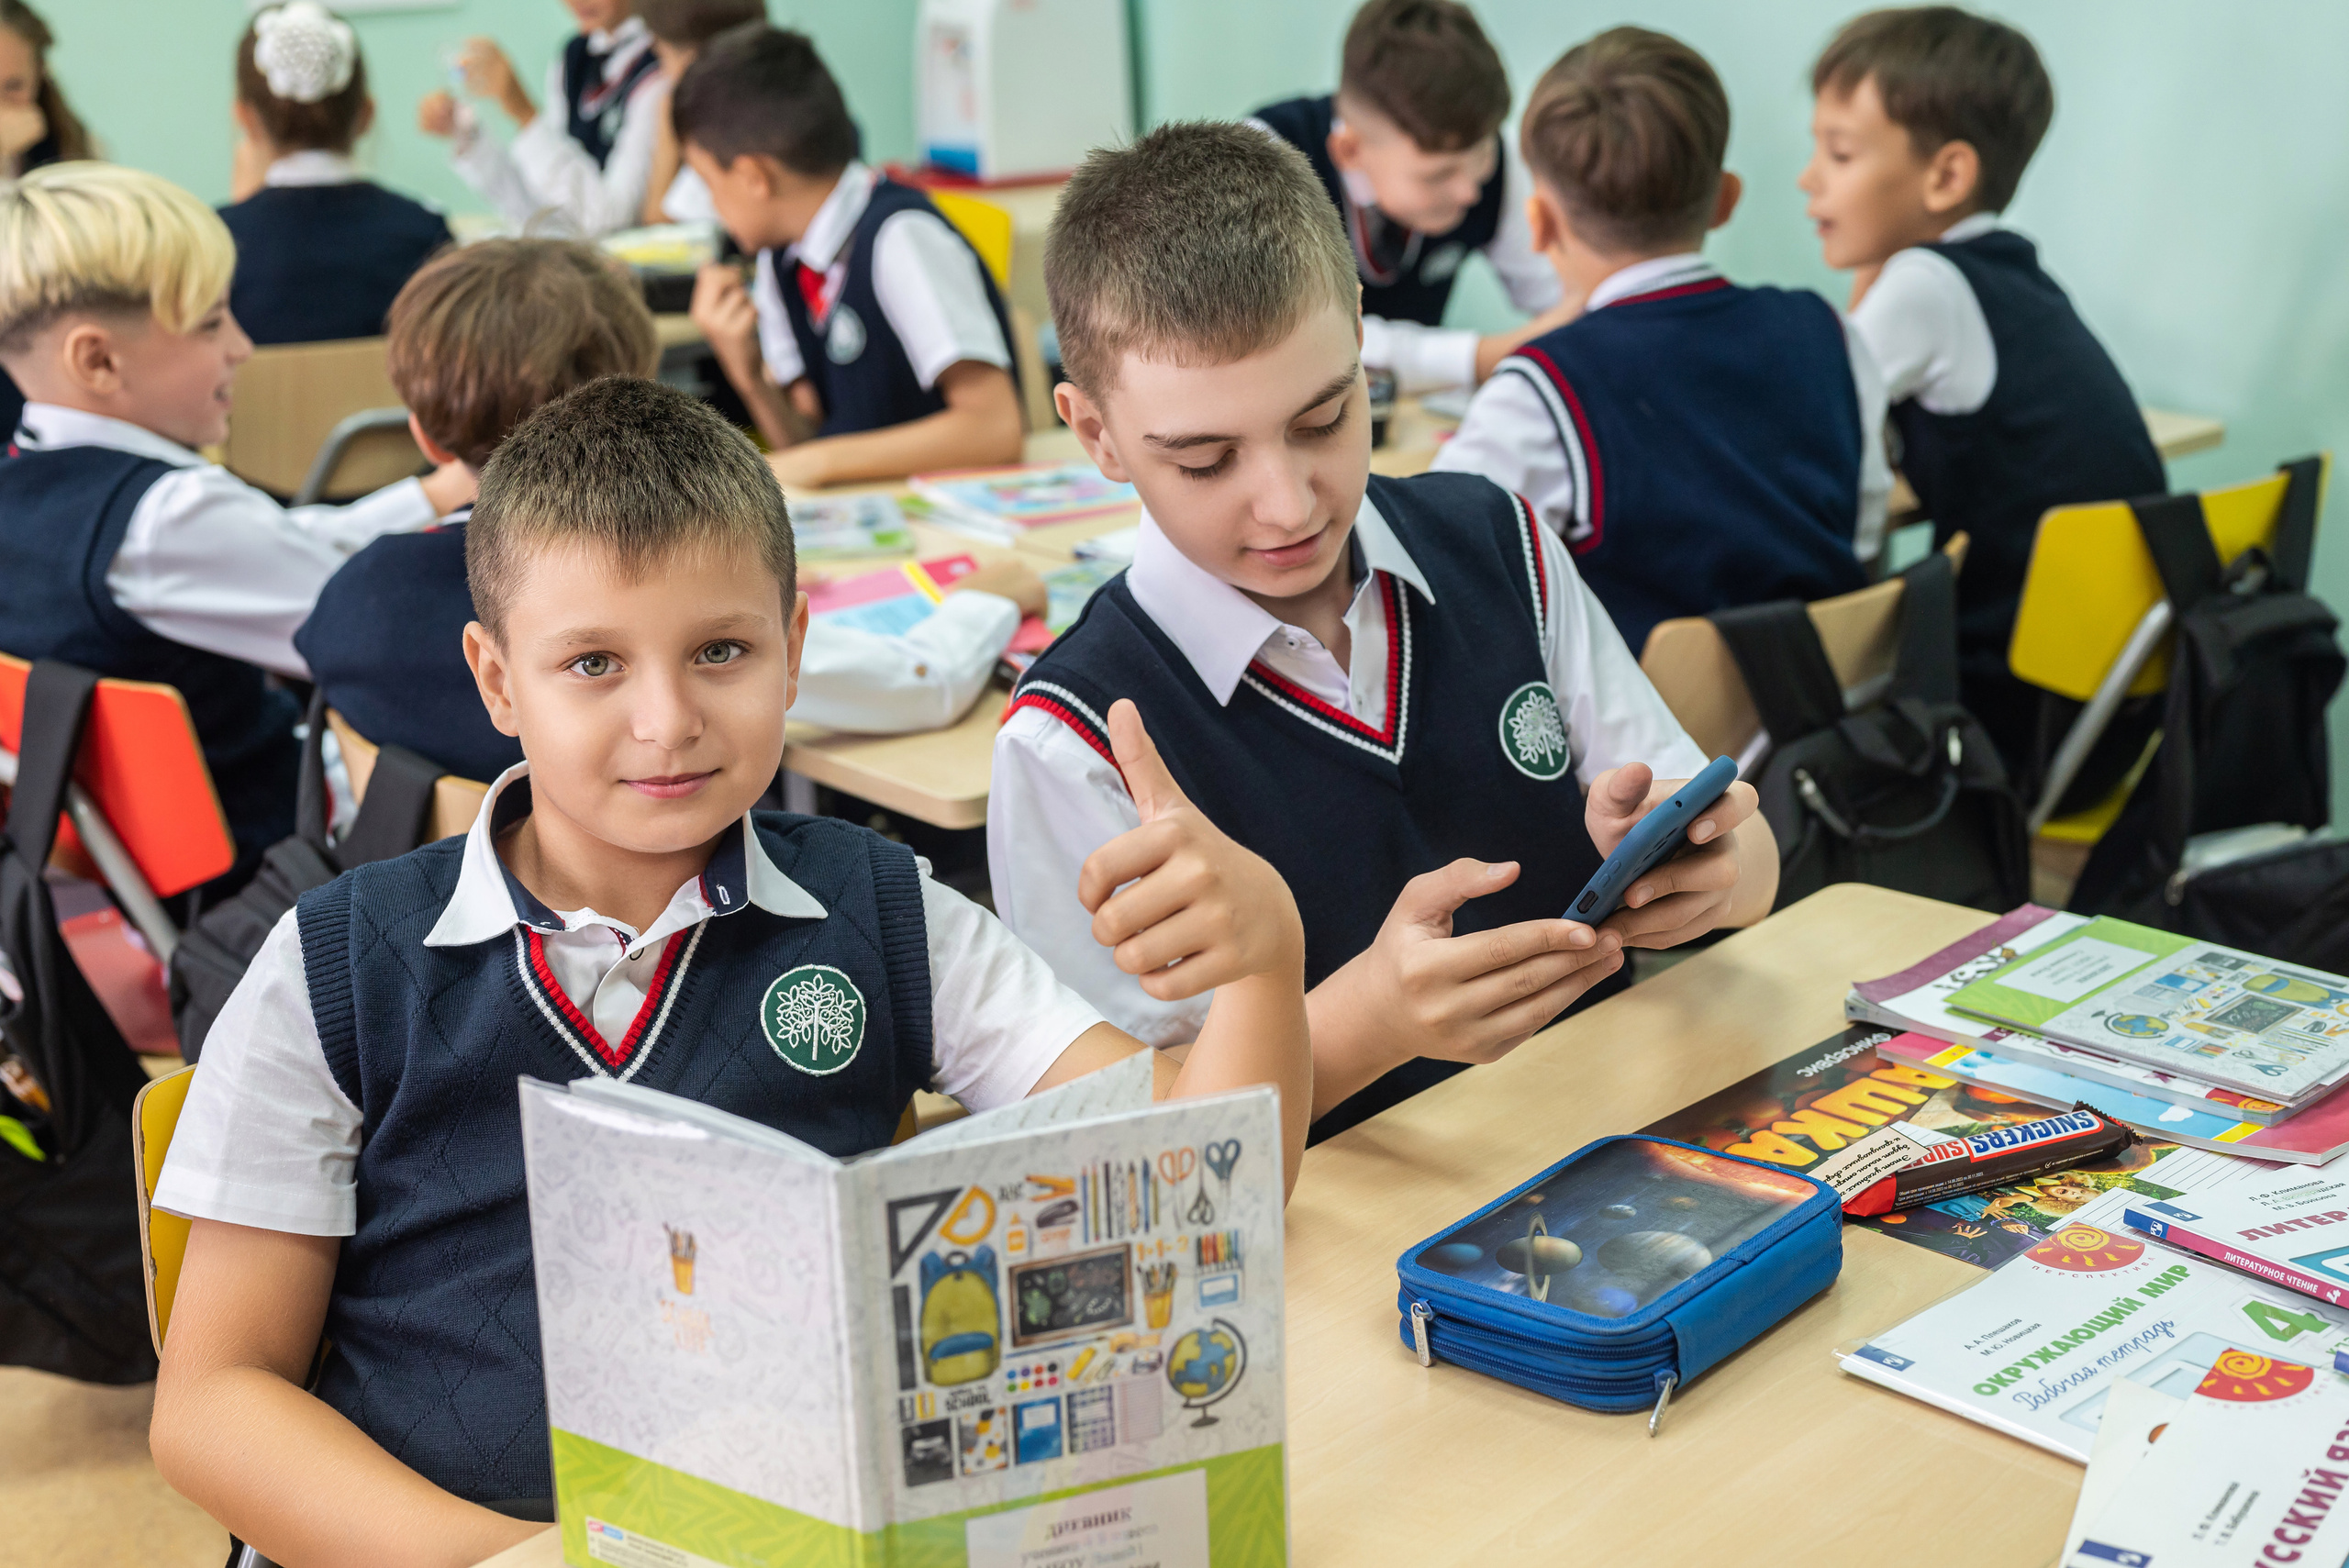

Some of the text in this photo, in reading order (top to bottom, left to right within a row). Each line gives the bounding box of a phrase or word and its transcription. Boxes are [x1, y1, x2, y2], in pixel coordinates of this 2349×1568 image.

[1968, 1111, 2095, 1153] SNICKERS
[1881, 1154, 1911, 1170] Этот
[1882, 1144, 1910, 1159] будет
[1857, 1158, 1882, 1173] полон
[2271, 1180, 2325, 1195] Климанова
[2236, 1207, 2349, 1241] ЛИТЕР
[2032, 1257, 2155, 1279] ПЕРСПЕКТИВА
[2224, 1251, 2319, 1293] ЛИТЕРАТУРНОЕ ЧТЕНИЕ
[2326, 1289, 2342, 1304] 4
[1973, 1264, 2191, 1396] ОКРУЖАЮЩИЙ МИР
[1980, 1318, 2022, 1340] Плешаков
[2242, 1300, 2332, 1343] 4
[2001, 1322, 2043, 1345] Новицкая
[2012, 1319, 2175, 1411] Рабочая тетрадь
[2254, 1468, 2349, 1568] ССКИЙ
